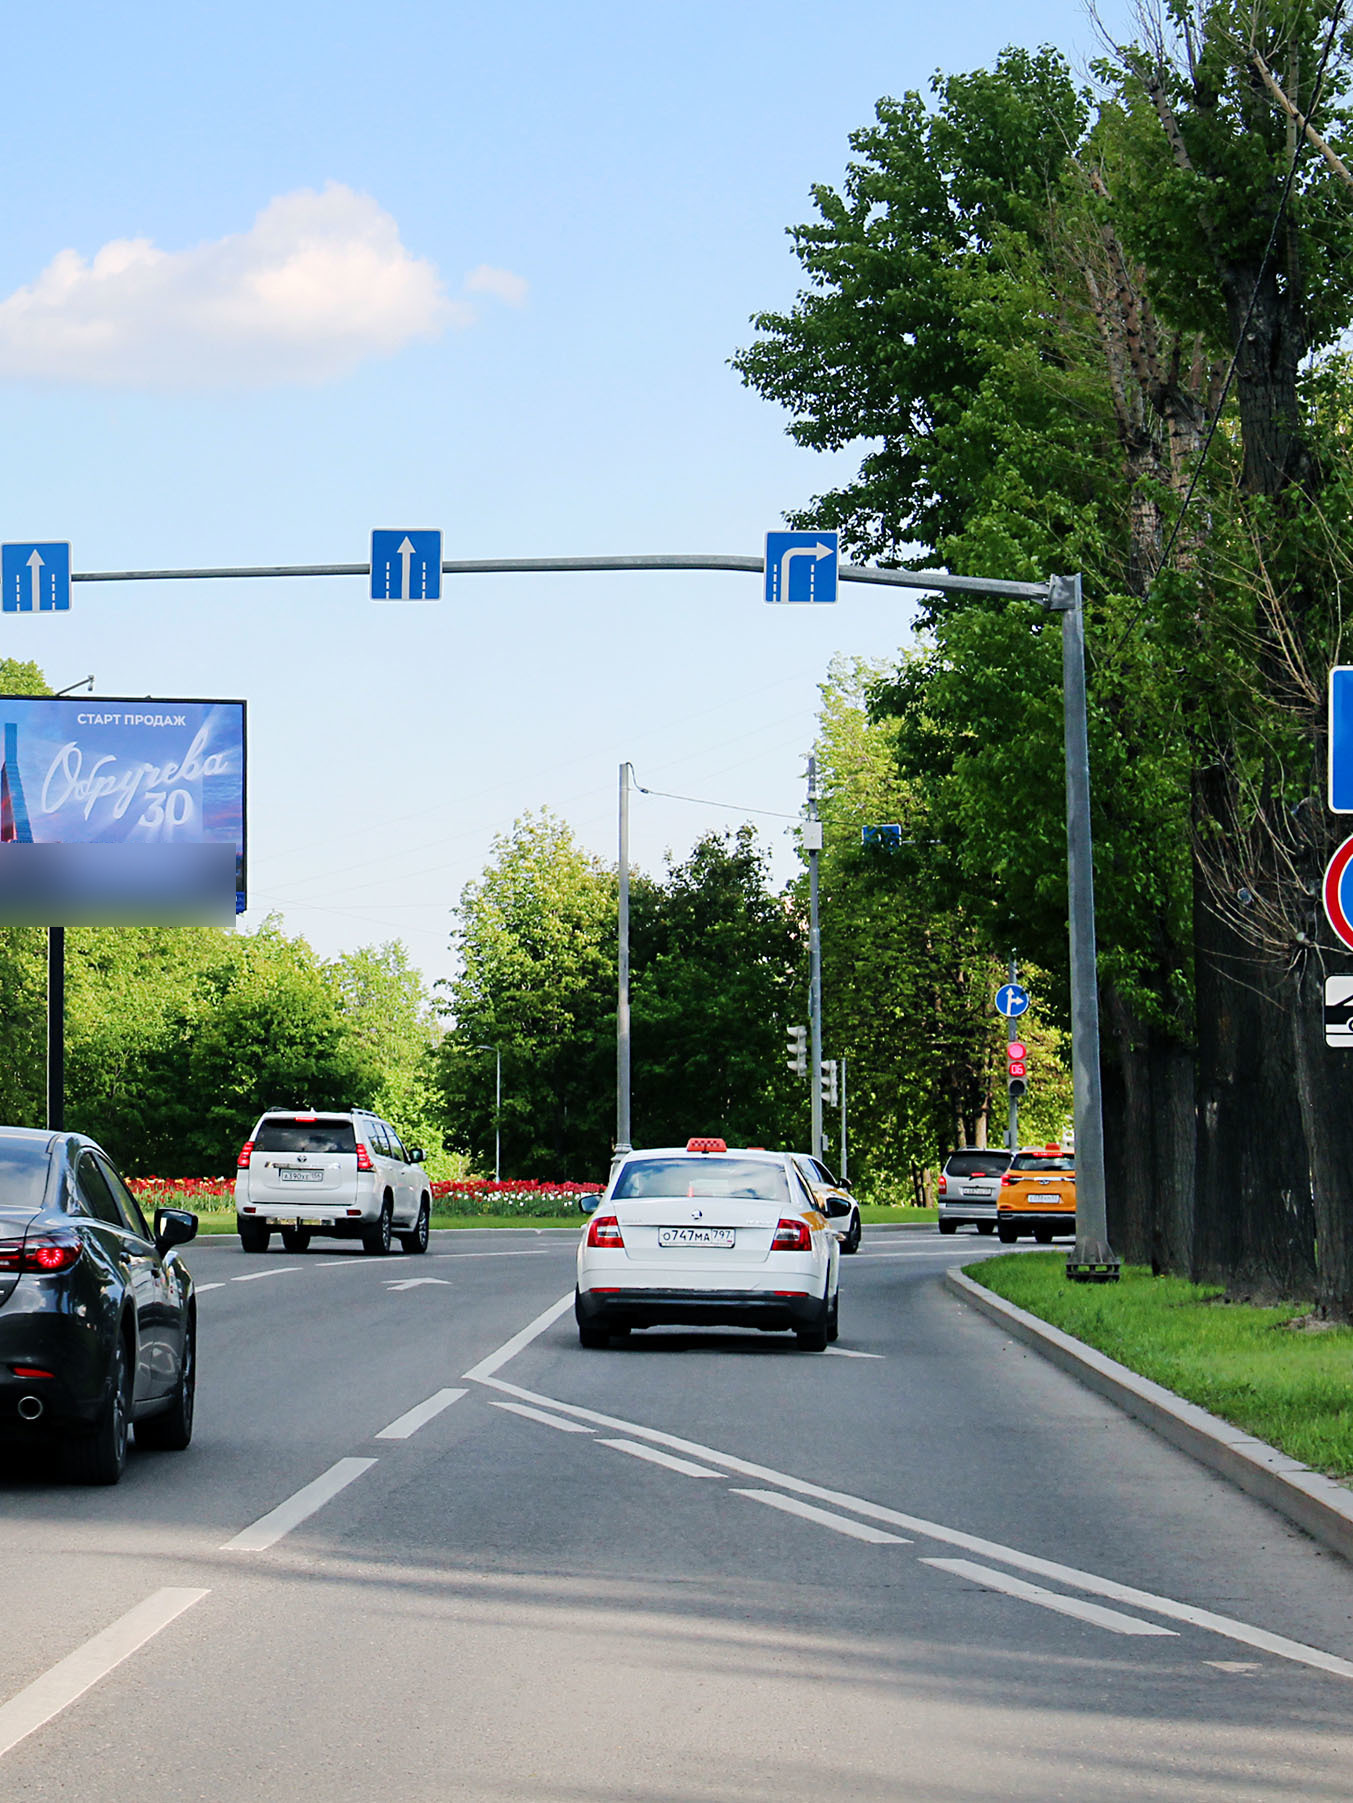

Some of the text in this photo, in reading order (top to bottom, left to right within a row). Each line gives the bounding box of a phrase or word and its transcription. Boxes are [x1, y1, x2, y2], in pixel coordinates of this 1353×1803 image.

[77, 713, 186, 727] СТАРТ ПРОДАЖ
[40, 727, 229, 821] Обручева
[138, 789, 193, 827] 30
[1011, 1064, 1024, 1074] 06
[712, 1230, 731, 1240] 797
